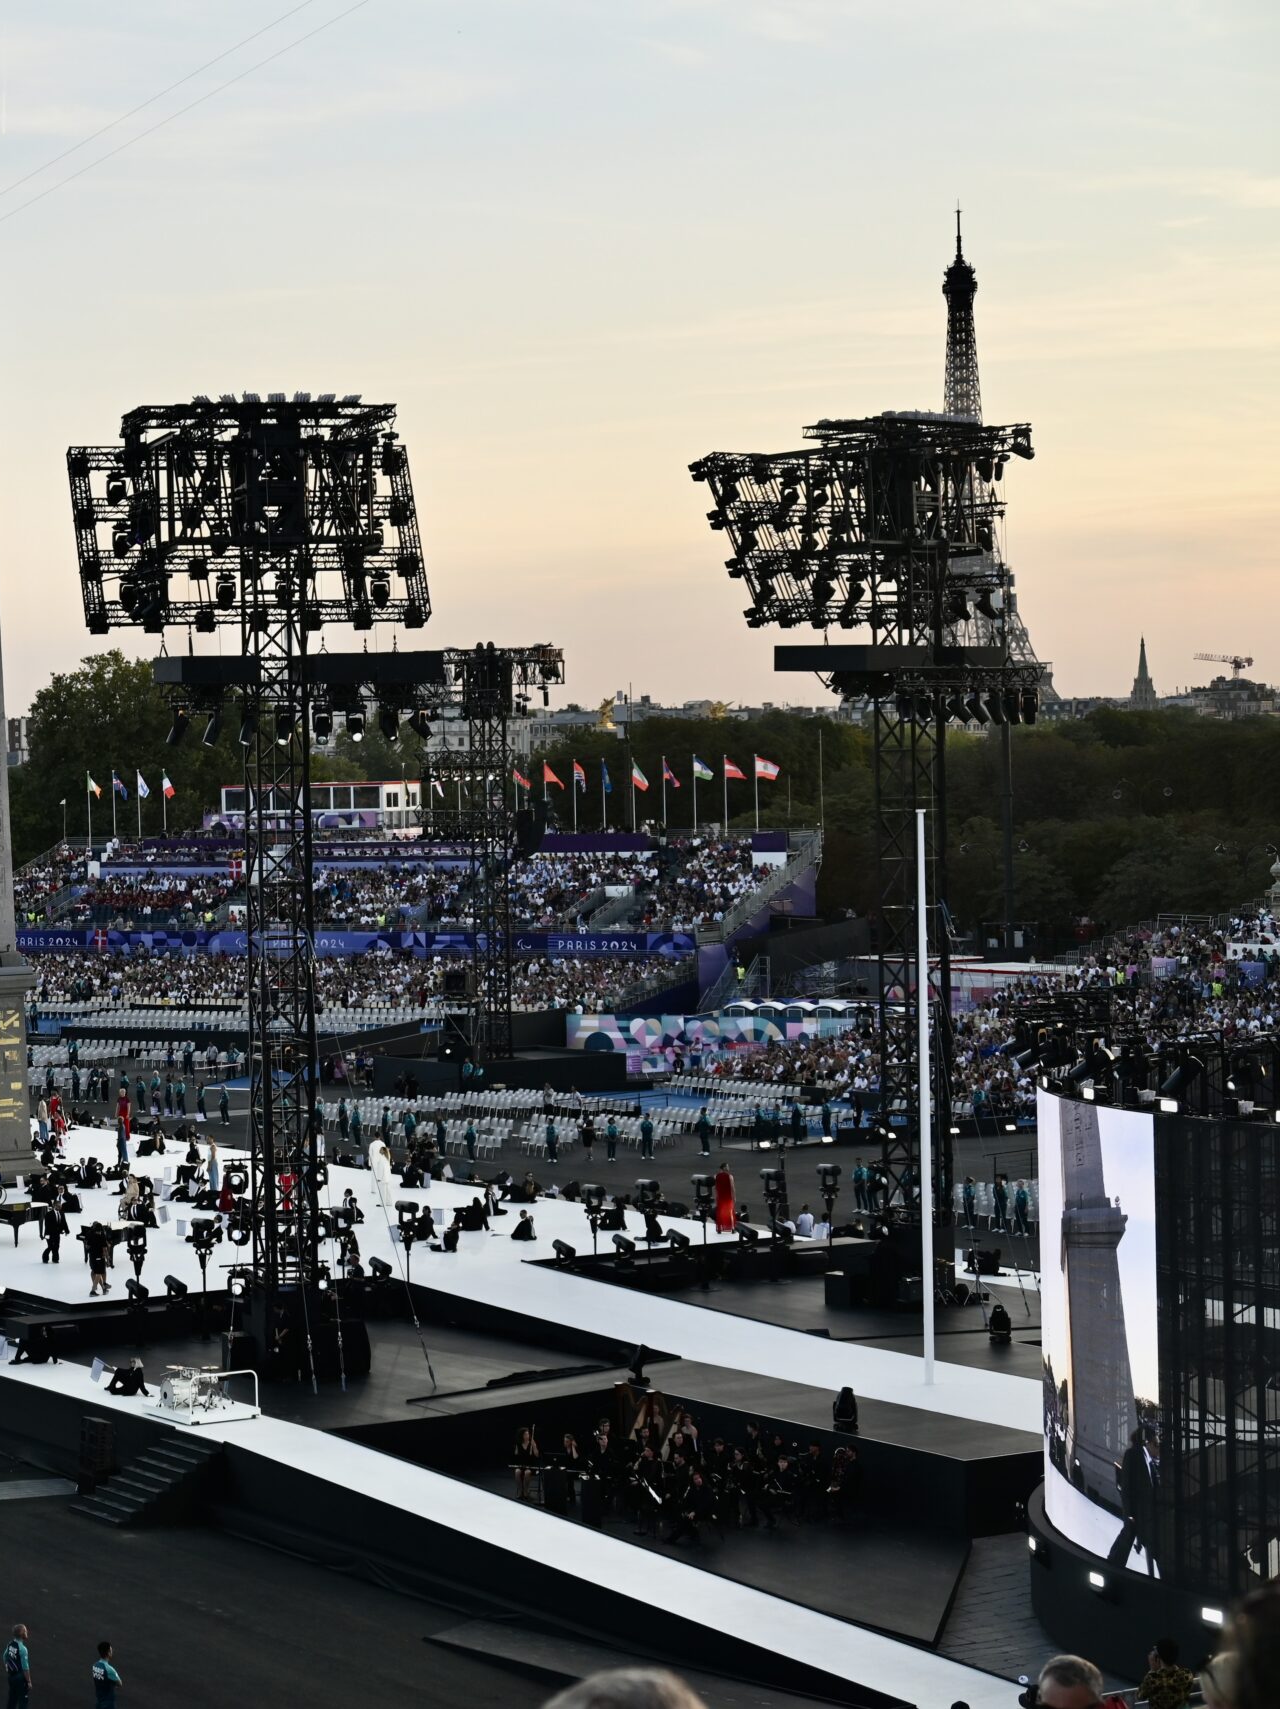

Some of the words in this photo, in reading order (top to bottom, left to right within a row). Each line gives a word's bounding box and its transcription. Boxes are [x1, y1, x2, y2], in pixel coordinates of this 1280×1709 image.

[48, 937, 78, 946] 2024
[314, 938, 345, 948] 2024
[558, 940, 596, 950] PARIS
[601, 940, 637, 950] 2024
